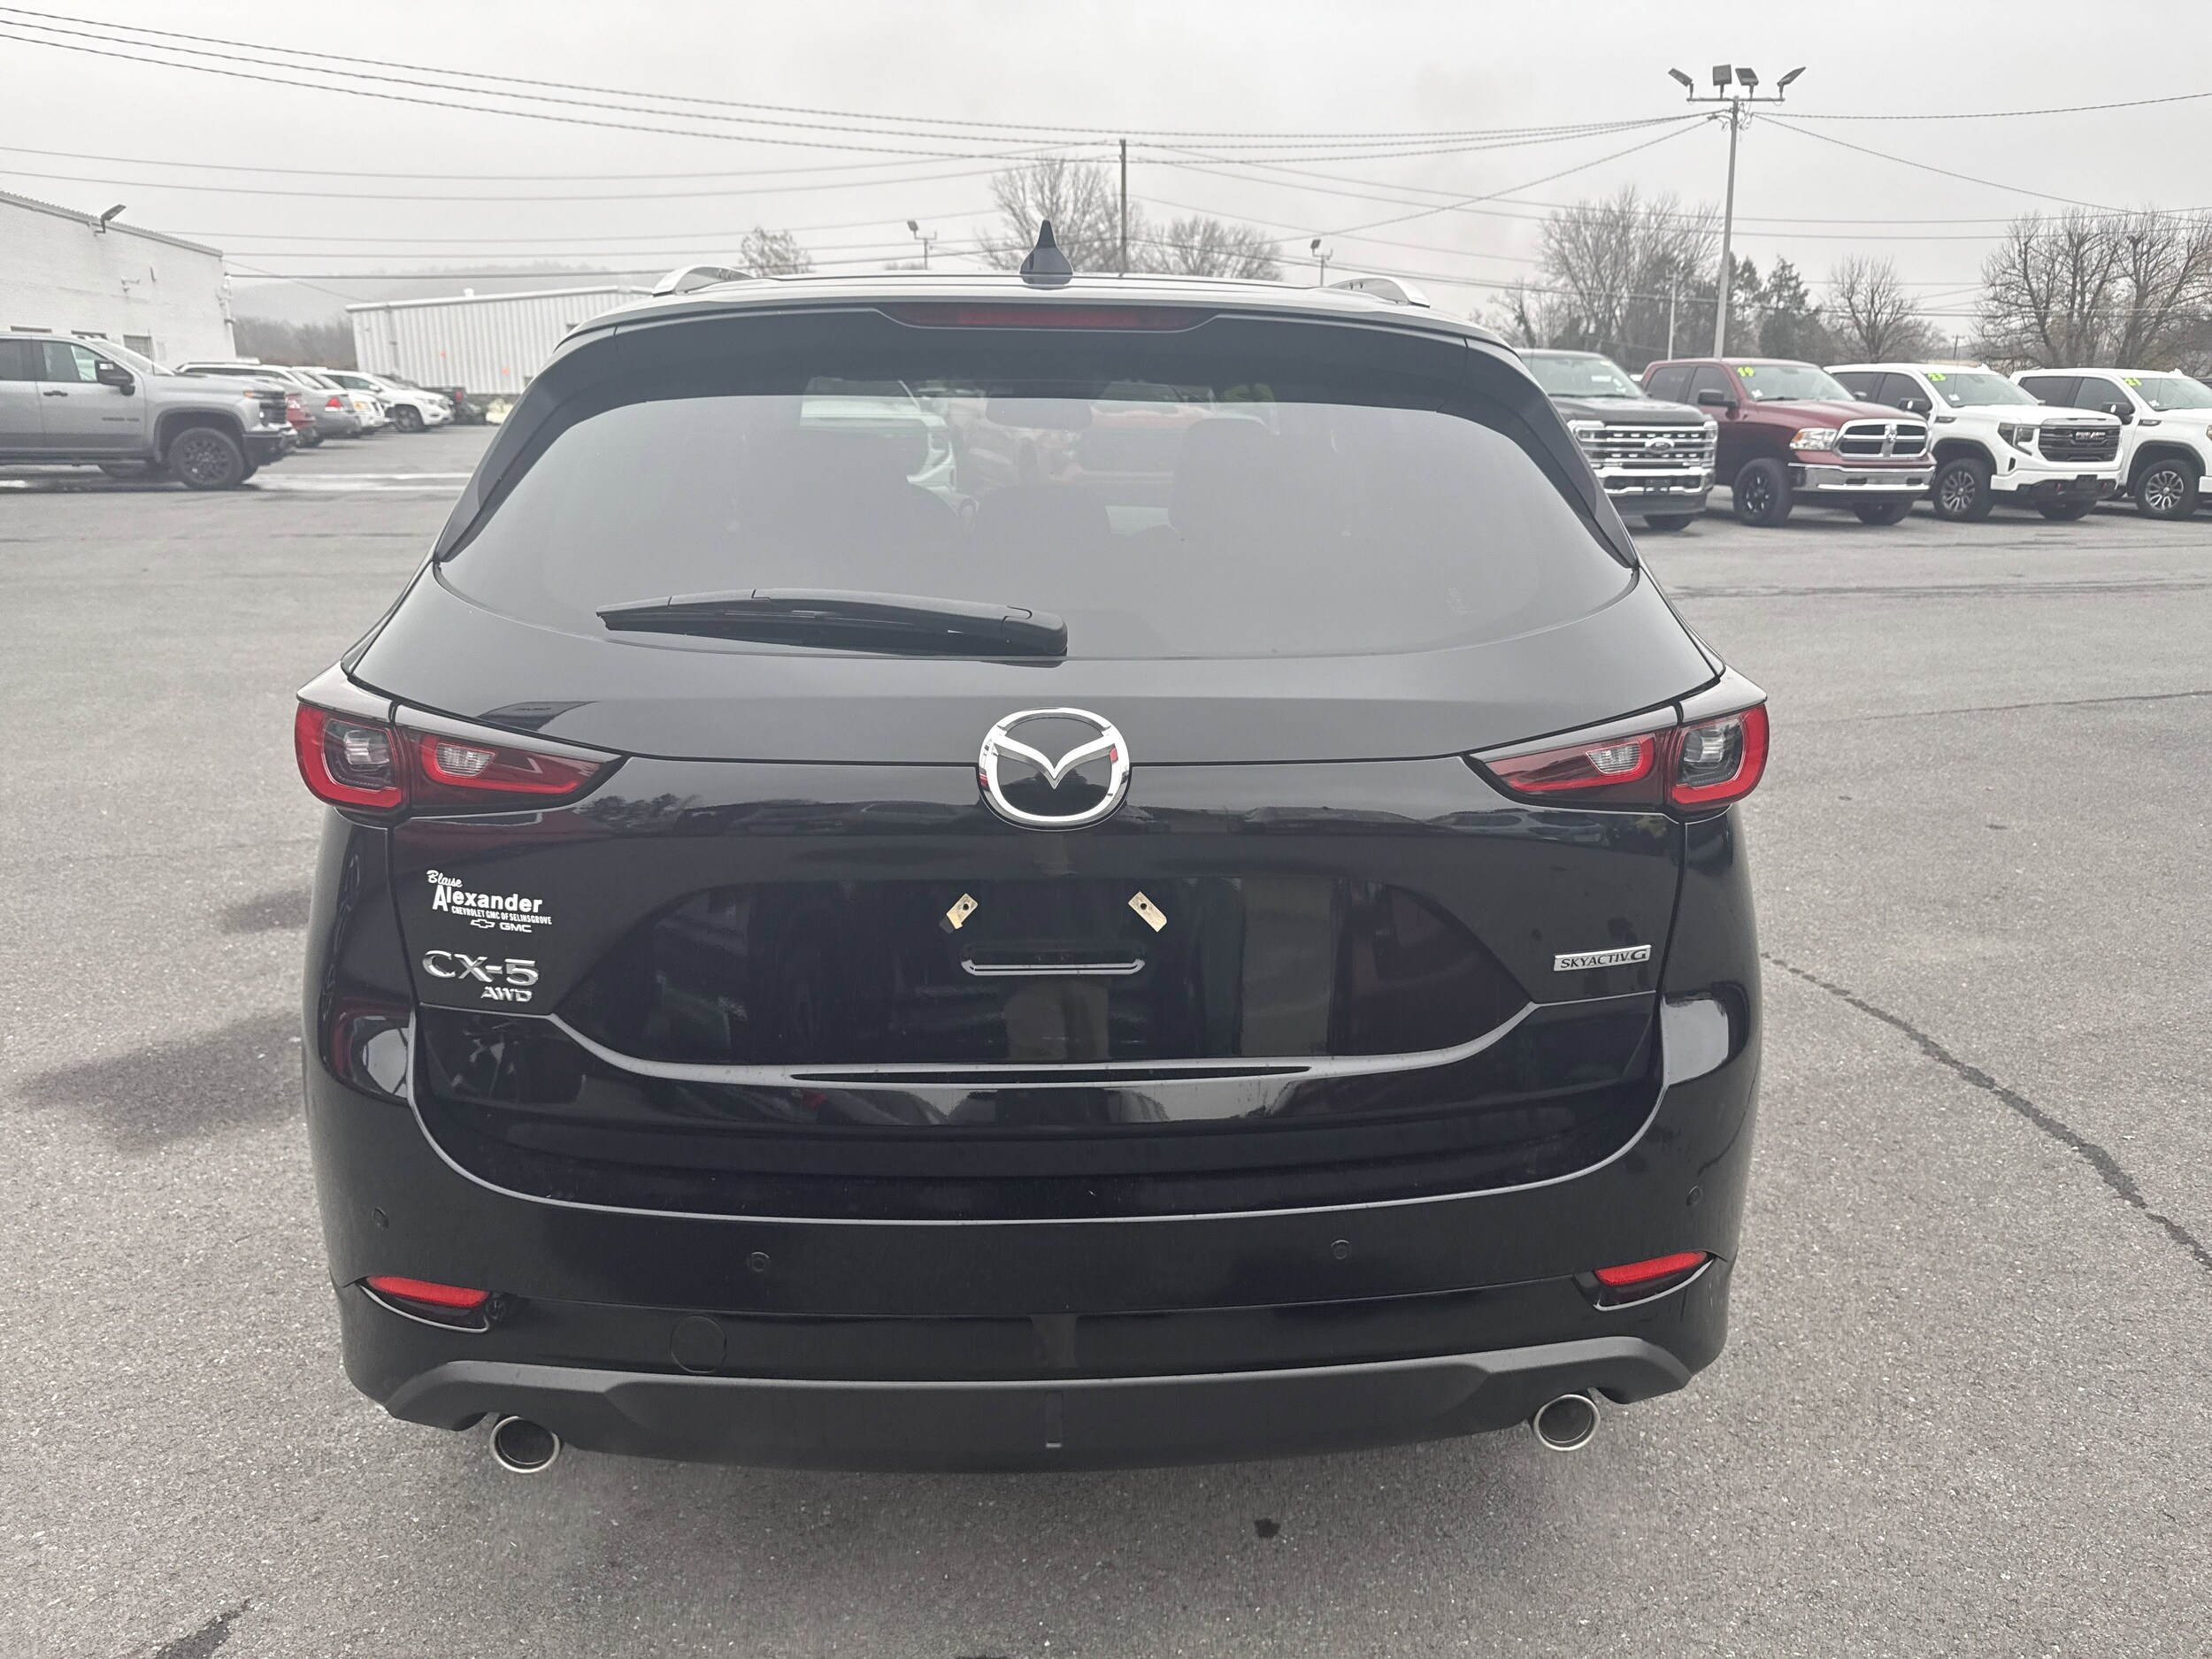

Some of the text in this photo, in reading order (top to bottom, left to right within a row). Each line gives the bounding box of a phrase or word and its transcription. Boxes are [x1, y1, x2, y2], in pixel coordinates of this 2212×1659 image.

[426, 870, 463, 888] Blaise
[432, 884, 543, 913] Alexander
[451, 905, 485, 918] CHEVROLET
[486, 910, 500, 920] GMC
[509, 913, 553, 926] SELINSGROVE
[499, 921, 533, 933] GMC
[422, 949, 540, 987] CX-5
[480, 986, 533, 1002] AWD
